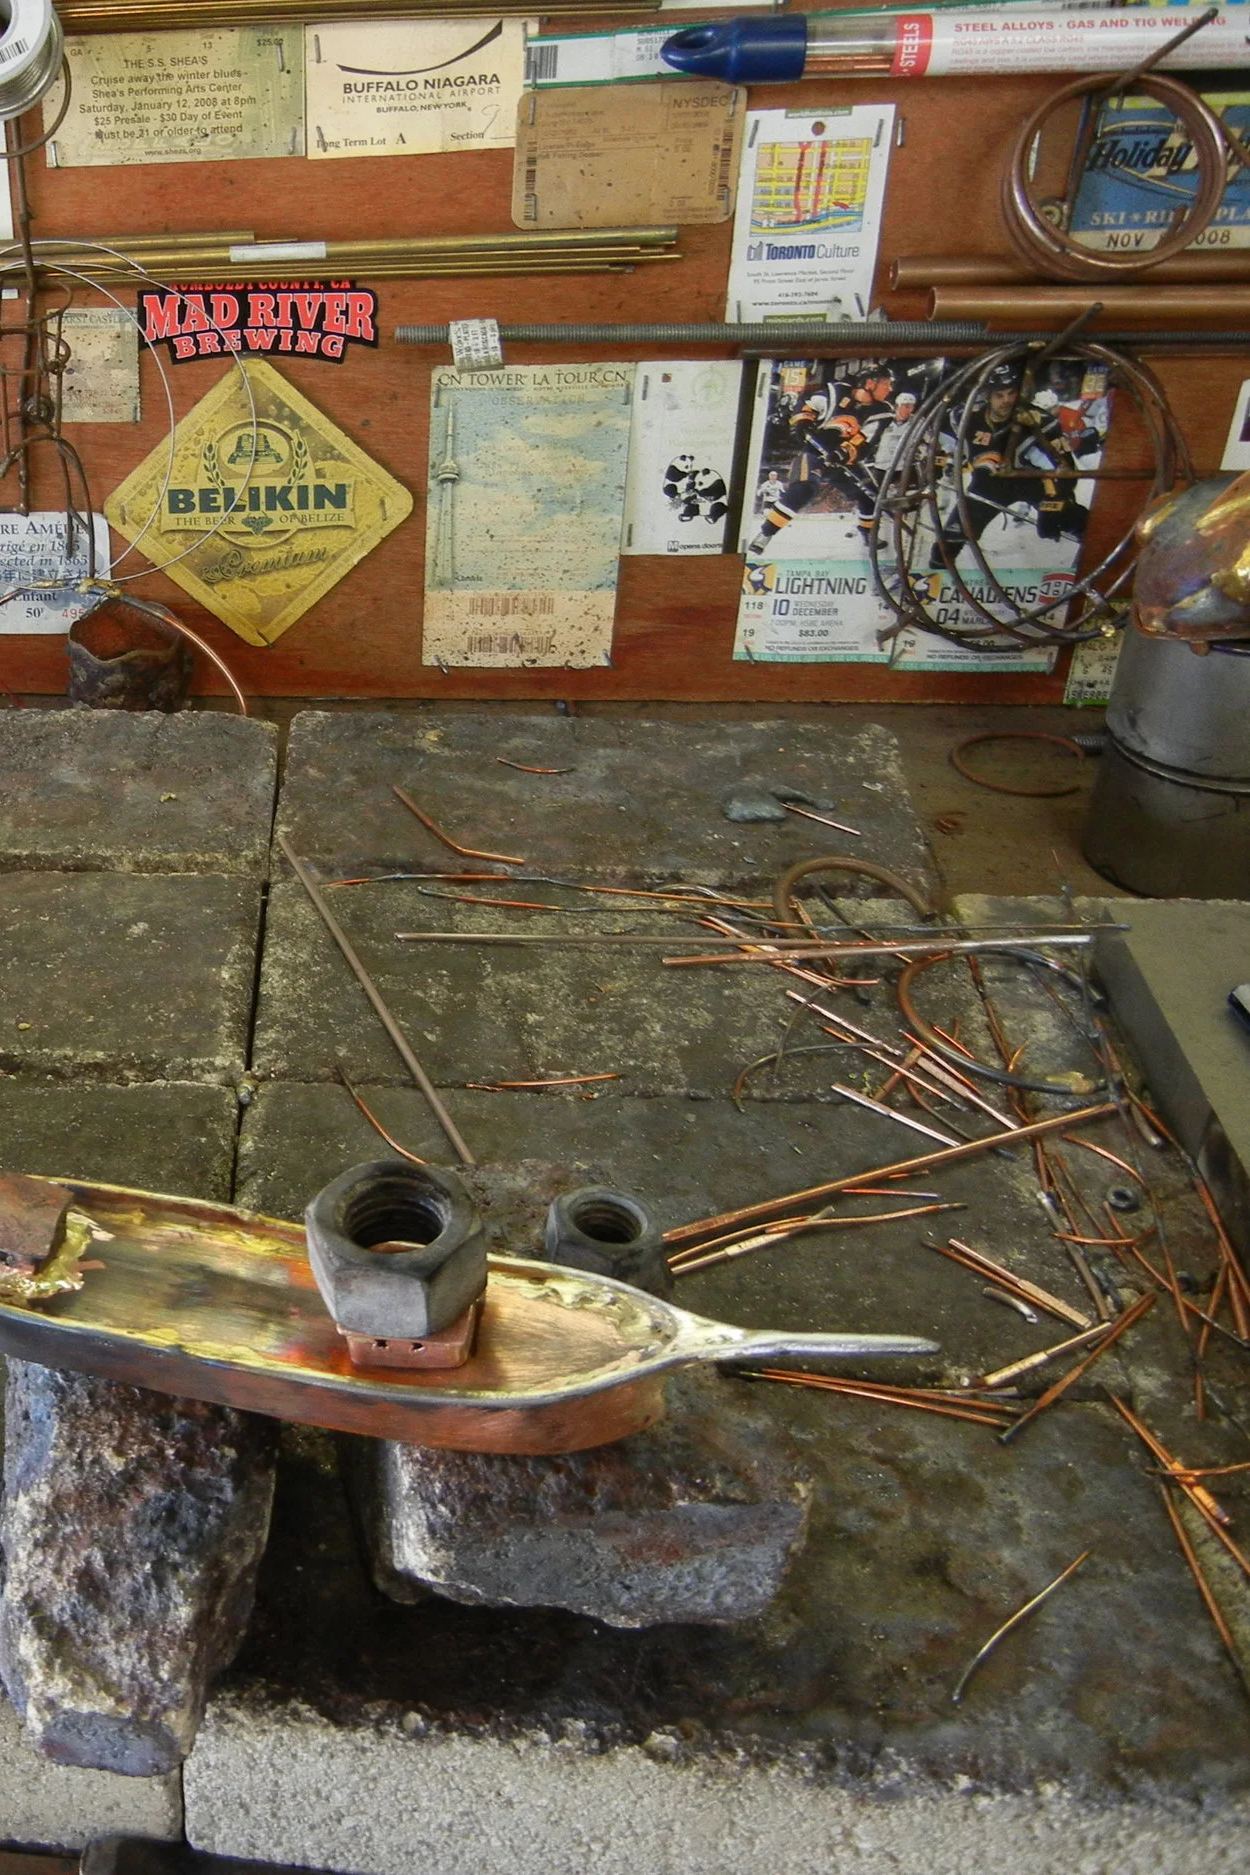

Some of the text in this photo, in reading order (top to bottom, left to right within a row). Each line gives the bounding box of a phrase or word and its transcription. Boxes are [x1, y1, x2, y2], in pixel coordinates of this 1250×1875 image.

[954, 18, 1128, 32] STEEL ALLOYS GAS AND
[901, 23, 919, 67] STEELS
[124, 56, 208, 69] THE SHEA'S
[91, 69, 241, 86] Cruise away the winter blues
[343, 74, 500, 94] BUFFALO NIAGARA
[93, 83, 242, 99] Shea's Performing Arts Center
[342, 87, 500, 104] INTERNATIONAL AIRPORT
[131, 96, 256, 112] January 2008 at 8pm
[376, 102, 467, 114] BUFFALO, NEW YORK
[673, 95, 728, 108] NYSDEC
[94, 110, 242, 126] $25 Presale $30 Day of Event
[95, 129, 121, 140] Must
[123, 129, 135, 138] be
[138, 128, 149, 137] 21
[167, 126, 192, 136] older
[210, 124, 243, 134] attend
[317, 131, 485, 149] Long Term Lot A Section
[1085, 138, 1195, 172] Holiday
[1091, 212, 1125, 225] SKI
[1107, 234, 1145, 247] NOV
[766, 244, 859, 260] TORONTO Culture
[143, 293, 374, 342] MAD RIVER
[173, 329, 344, 359] BREWING
[438, 371, 626, 385] CN TOWER LA TOUR CN
[785, 369, 800, 385] 15
[167, 483, 347, 513] BELIKIN
[174, 512, 345, 525] THE BEER OF BELIZE
[39, 556, 52, 566] in
[59, 555, 88, 566] 1865
[200, 545, 326, 583] Premium
[775, 577, 867, 594] LIGHTNING
[745, 601, 763, 610] 118
[772, 599, 790, 616] 10
[793, 608, 838, 616] DECEMBER
[936, 608, 960, 624] 04
